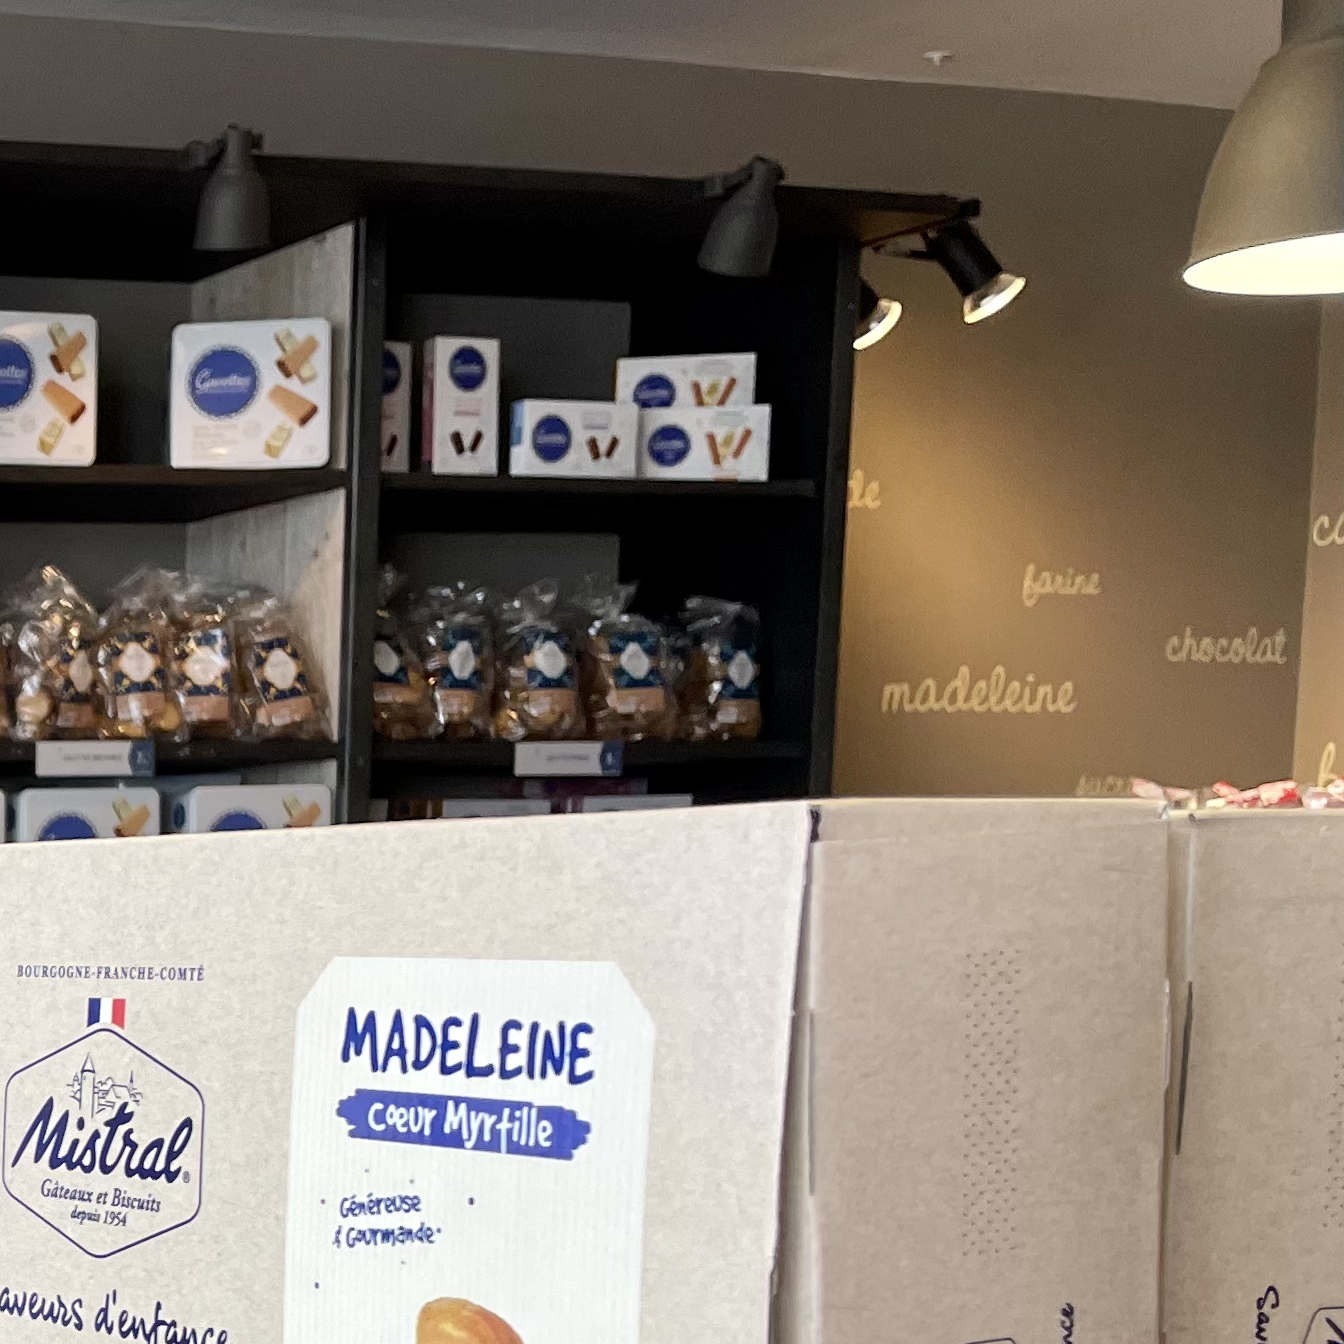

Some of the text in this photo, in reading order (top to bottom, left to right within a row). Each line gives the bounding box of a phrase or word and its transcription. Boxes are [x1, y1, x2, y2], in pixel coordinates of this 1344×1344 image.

[1023, 562, 1102, 607] farine
[1165, 625, 1287, 664] chocolat
[881, 664, 1077, 714] madeleine
[17, 964, 205, 982] BOURGOGNE-FRANCHE-COMTÉ
[341, 1007, 595, 1085] MADELEINE
[12, 1095, 193, 1184] Mistral
[444, 1100, 554, 1153] Myrtille
[41, 1179, 161, 1212] Gâteaux et Biscuits
[71, 1205, 127, 1226] depuis 1954
[340, 1192, 422, 1218] Généreuse
